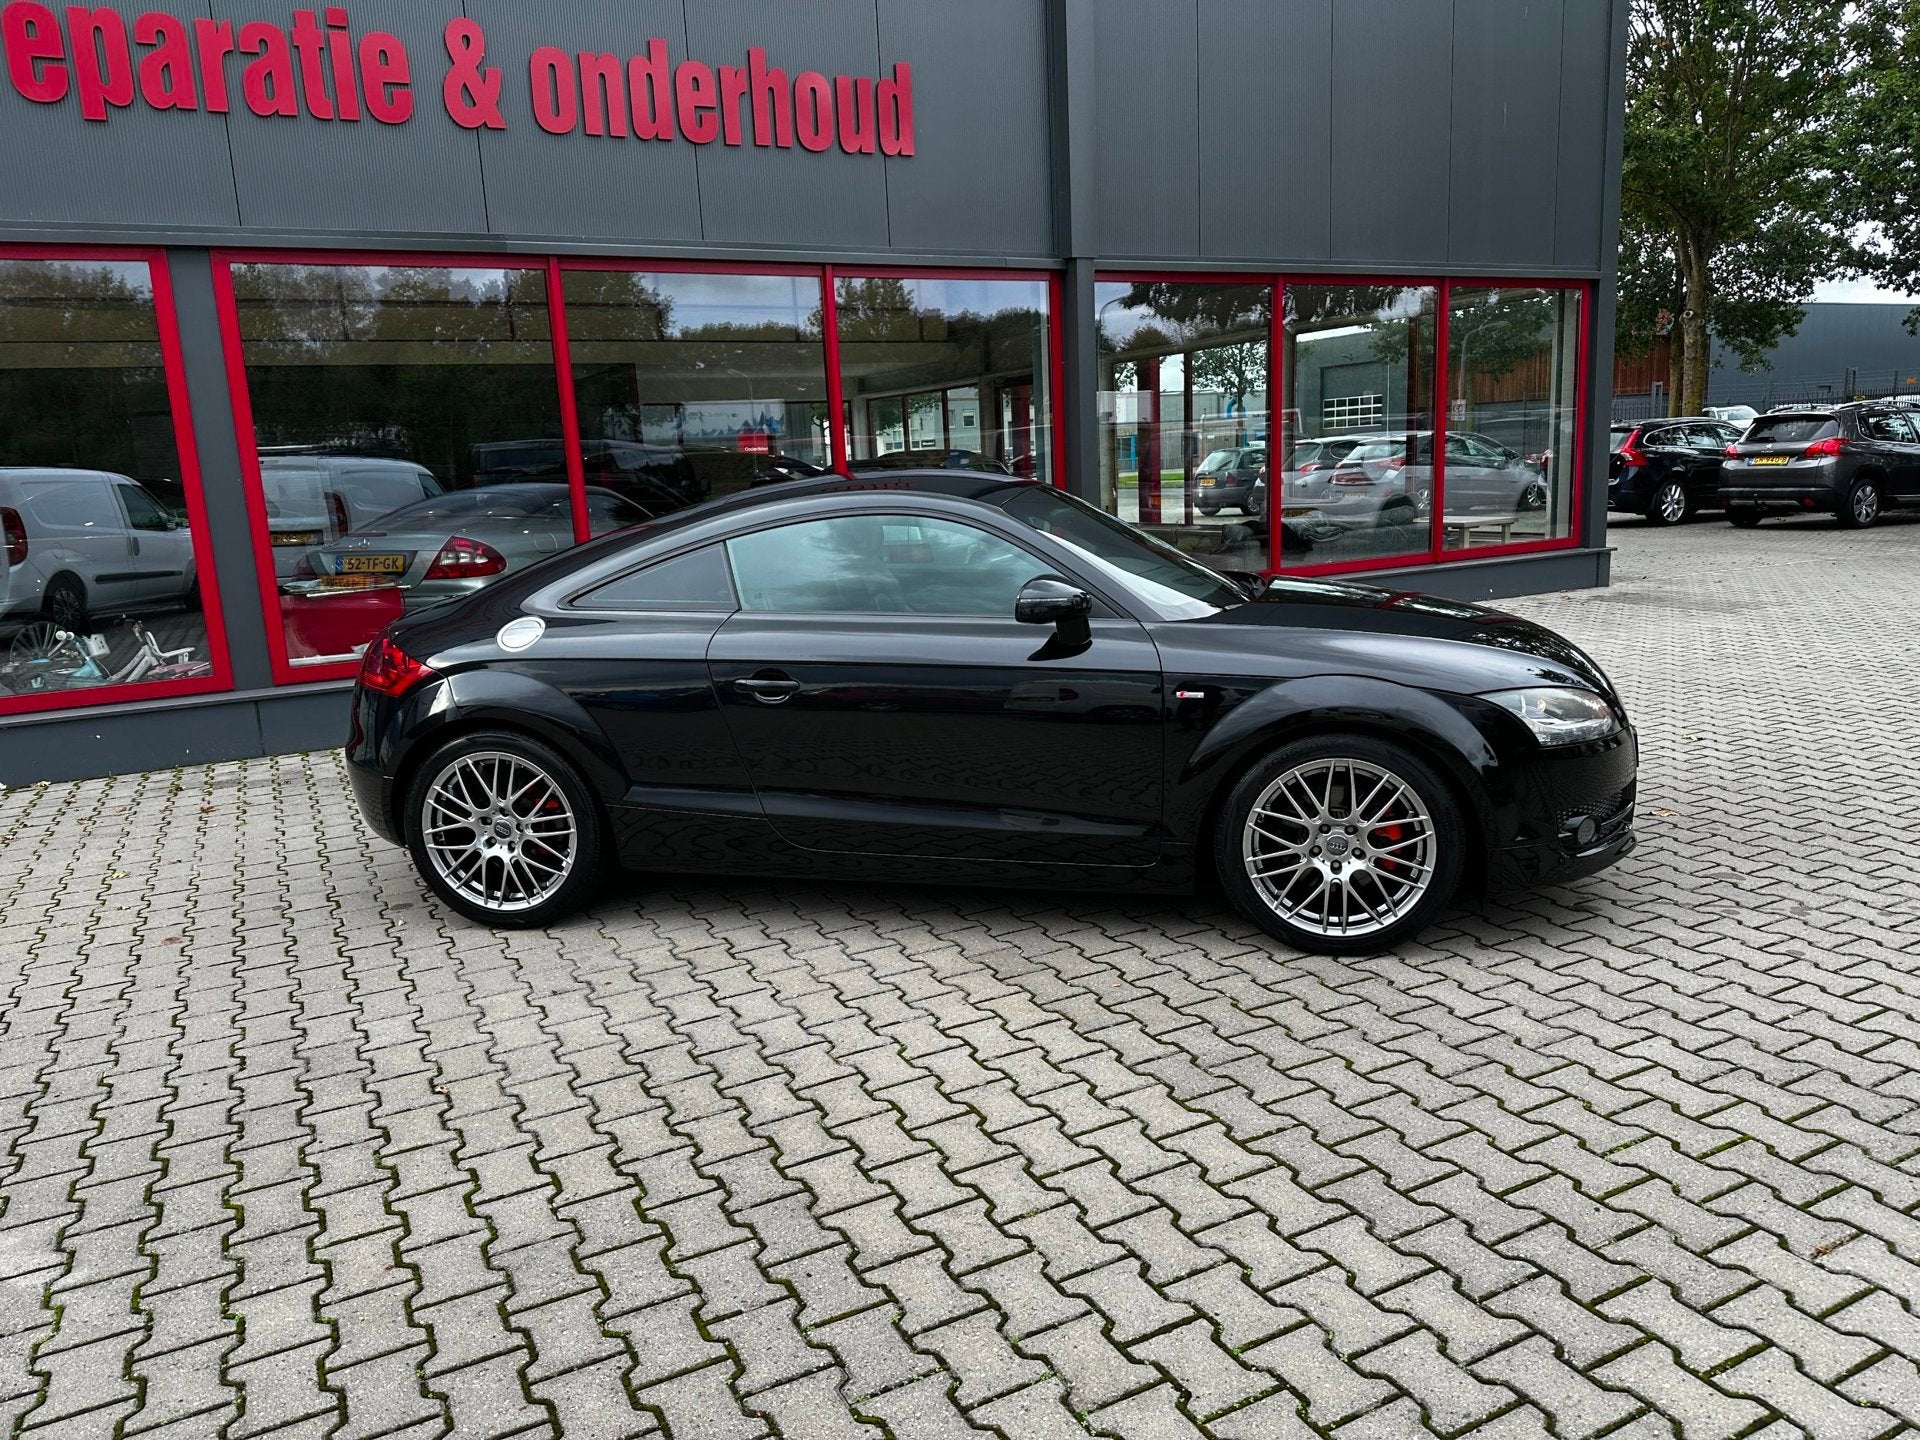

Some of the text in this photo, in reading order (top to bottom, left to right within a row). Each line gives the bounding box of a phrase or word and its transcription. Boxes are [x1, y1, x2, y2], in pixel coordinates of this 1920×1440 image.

[2, 0, 915, 157] eparatie & onderhoud
[347, 558, 399, 570] 52-TF-GK
